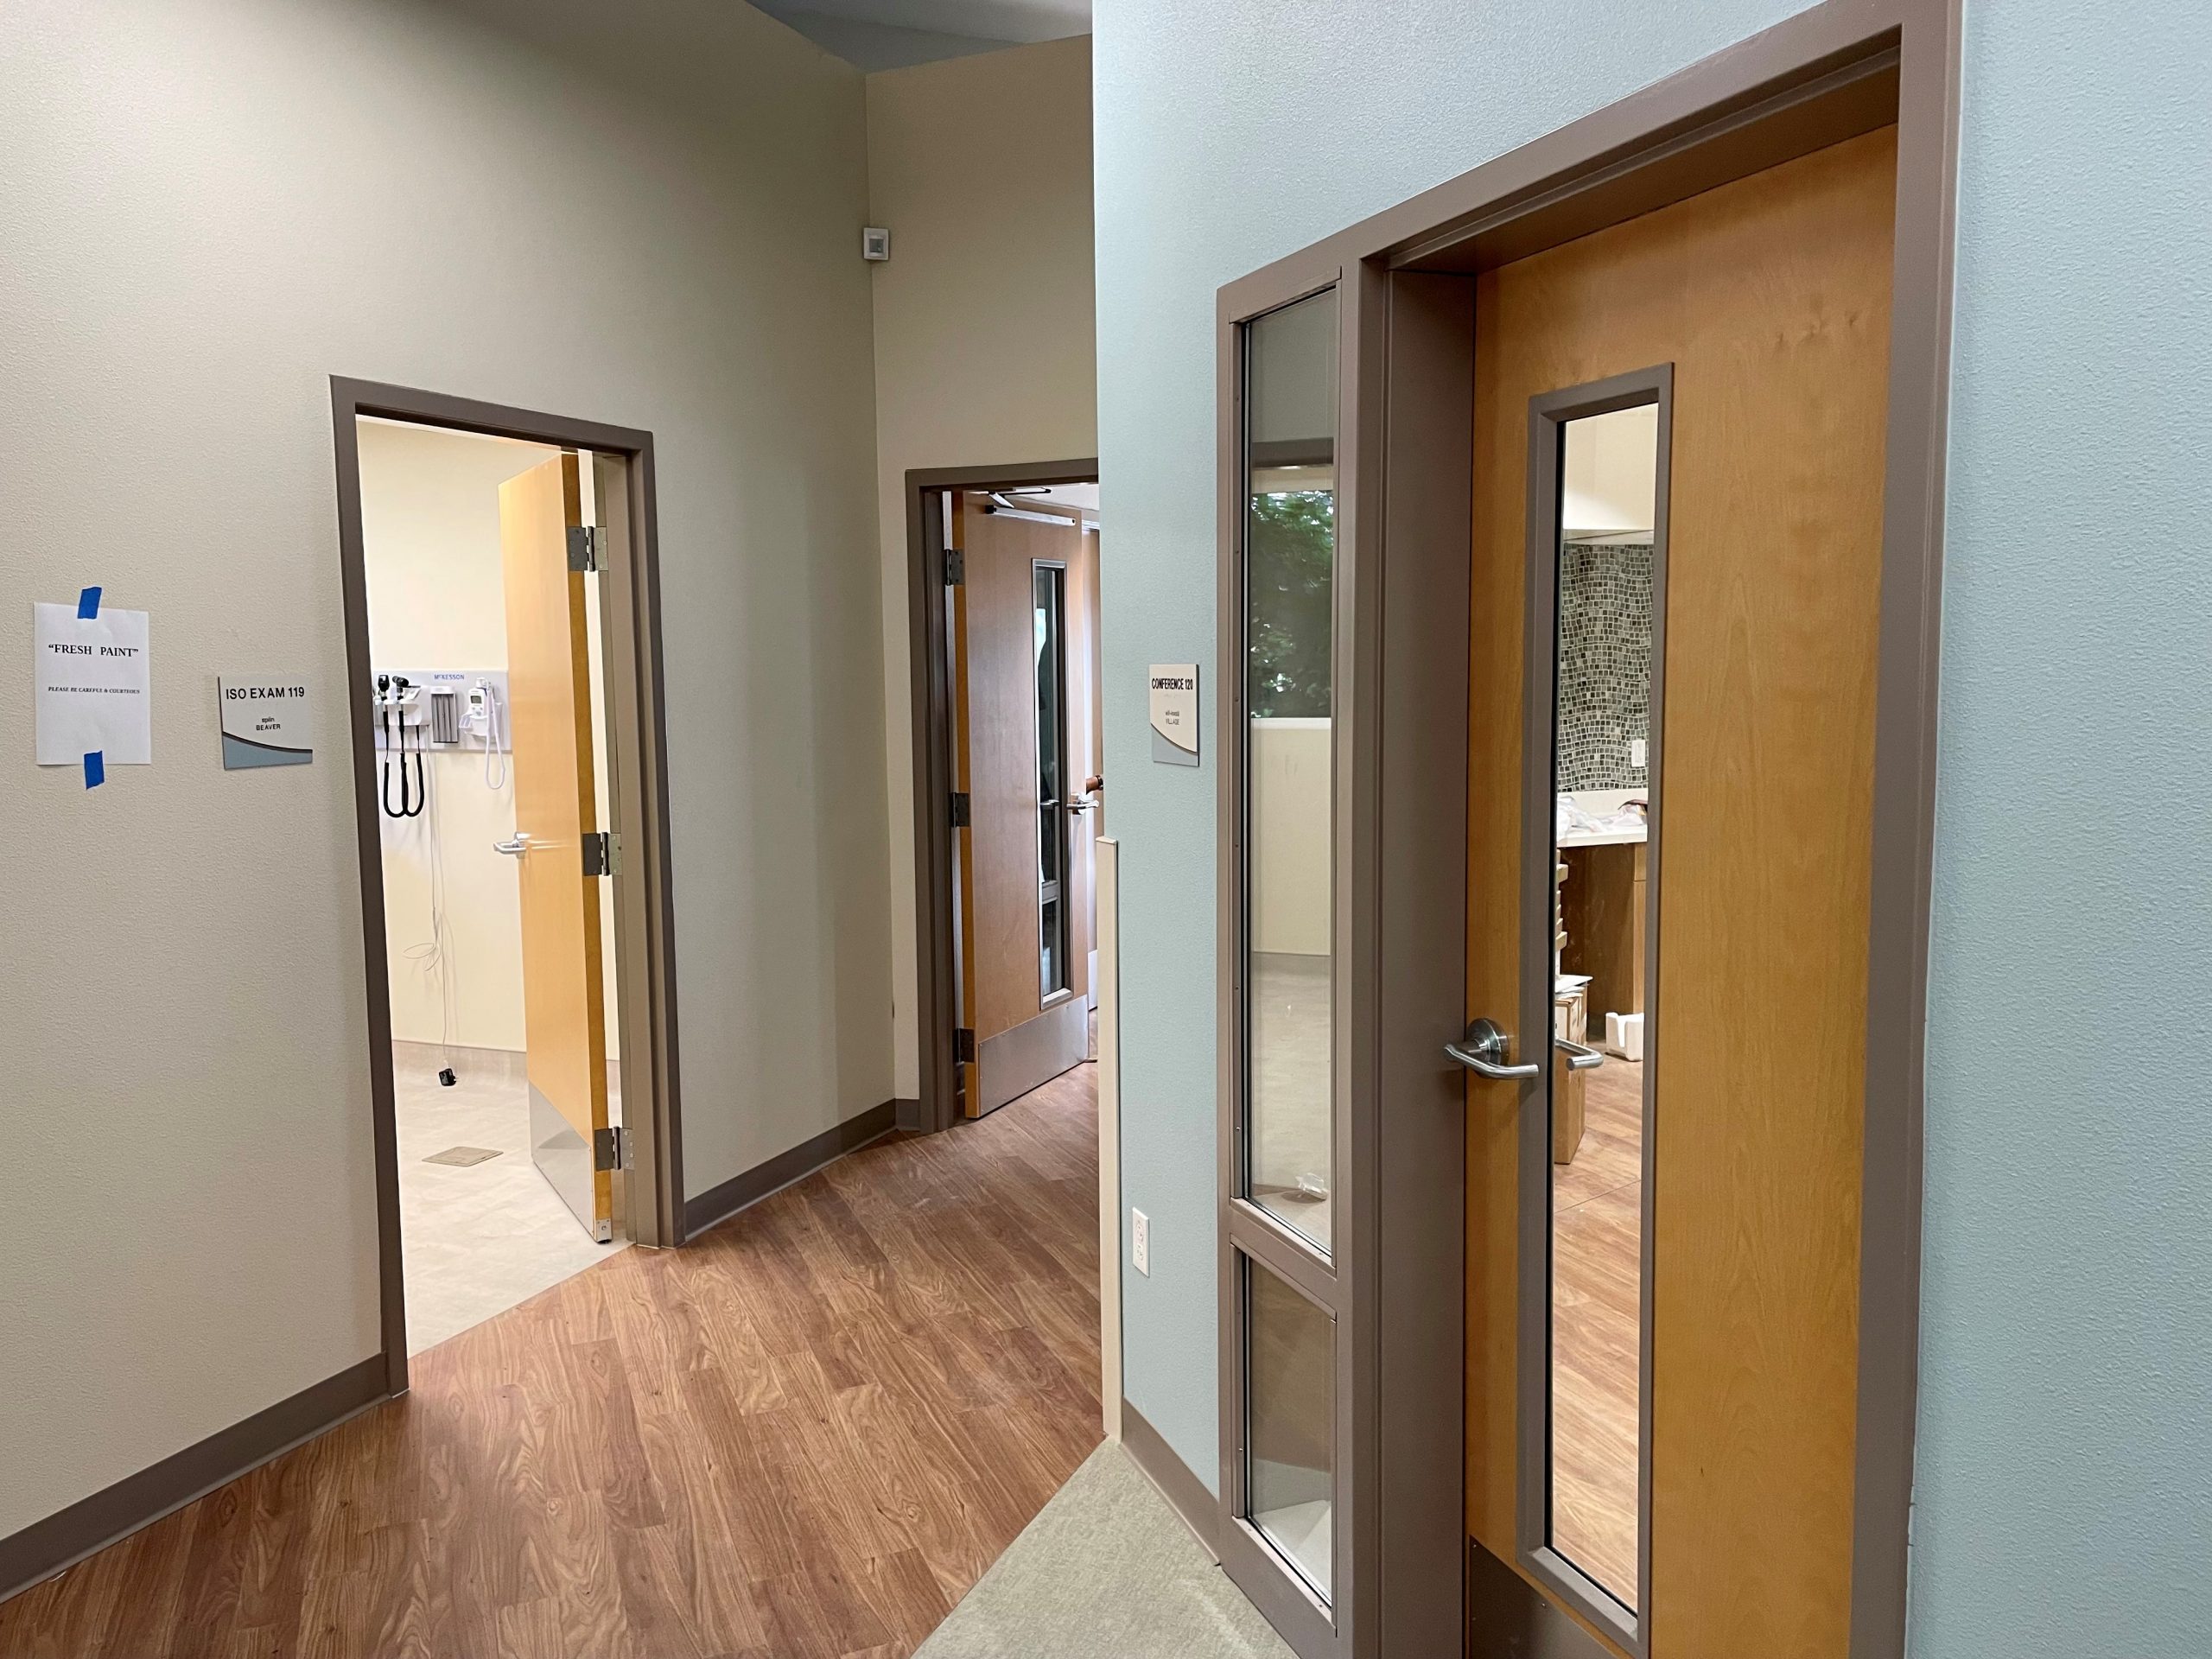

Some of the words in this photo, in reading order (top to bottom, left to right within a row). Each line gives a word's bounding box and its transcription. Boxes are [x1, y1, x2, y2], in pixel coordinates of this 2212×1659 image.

[1152, 678, 1184, 690] CONFERENCE
[1185, 678, 1193, 690] 120
[226, 689, 246, 699] ISO
[250, 687, 285, 699] EXAM
[288, 687, 305, 697] 119
